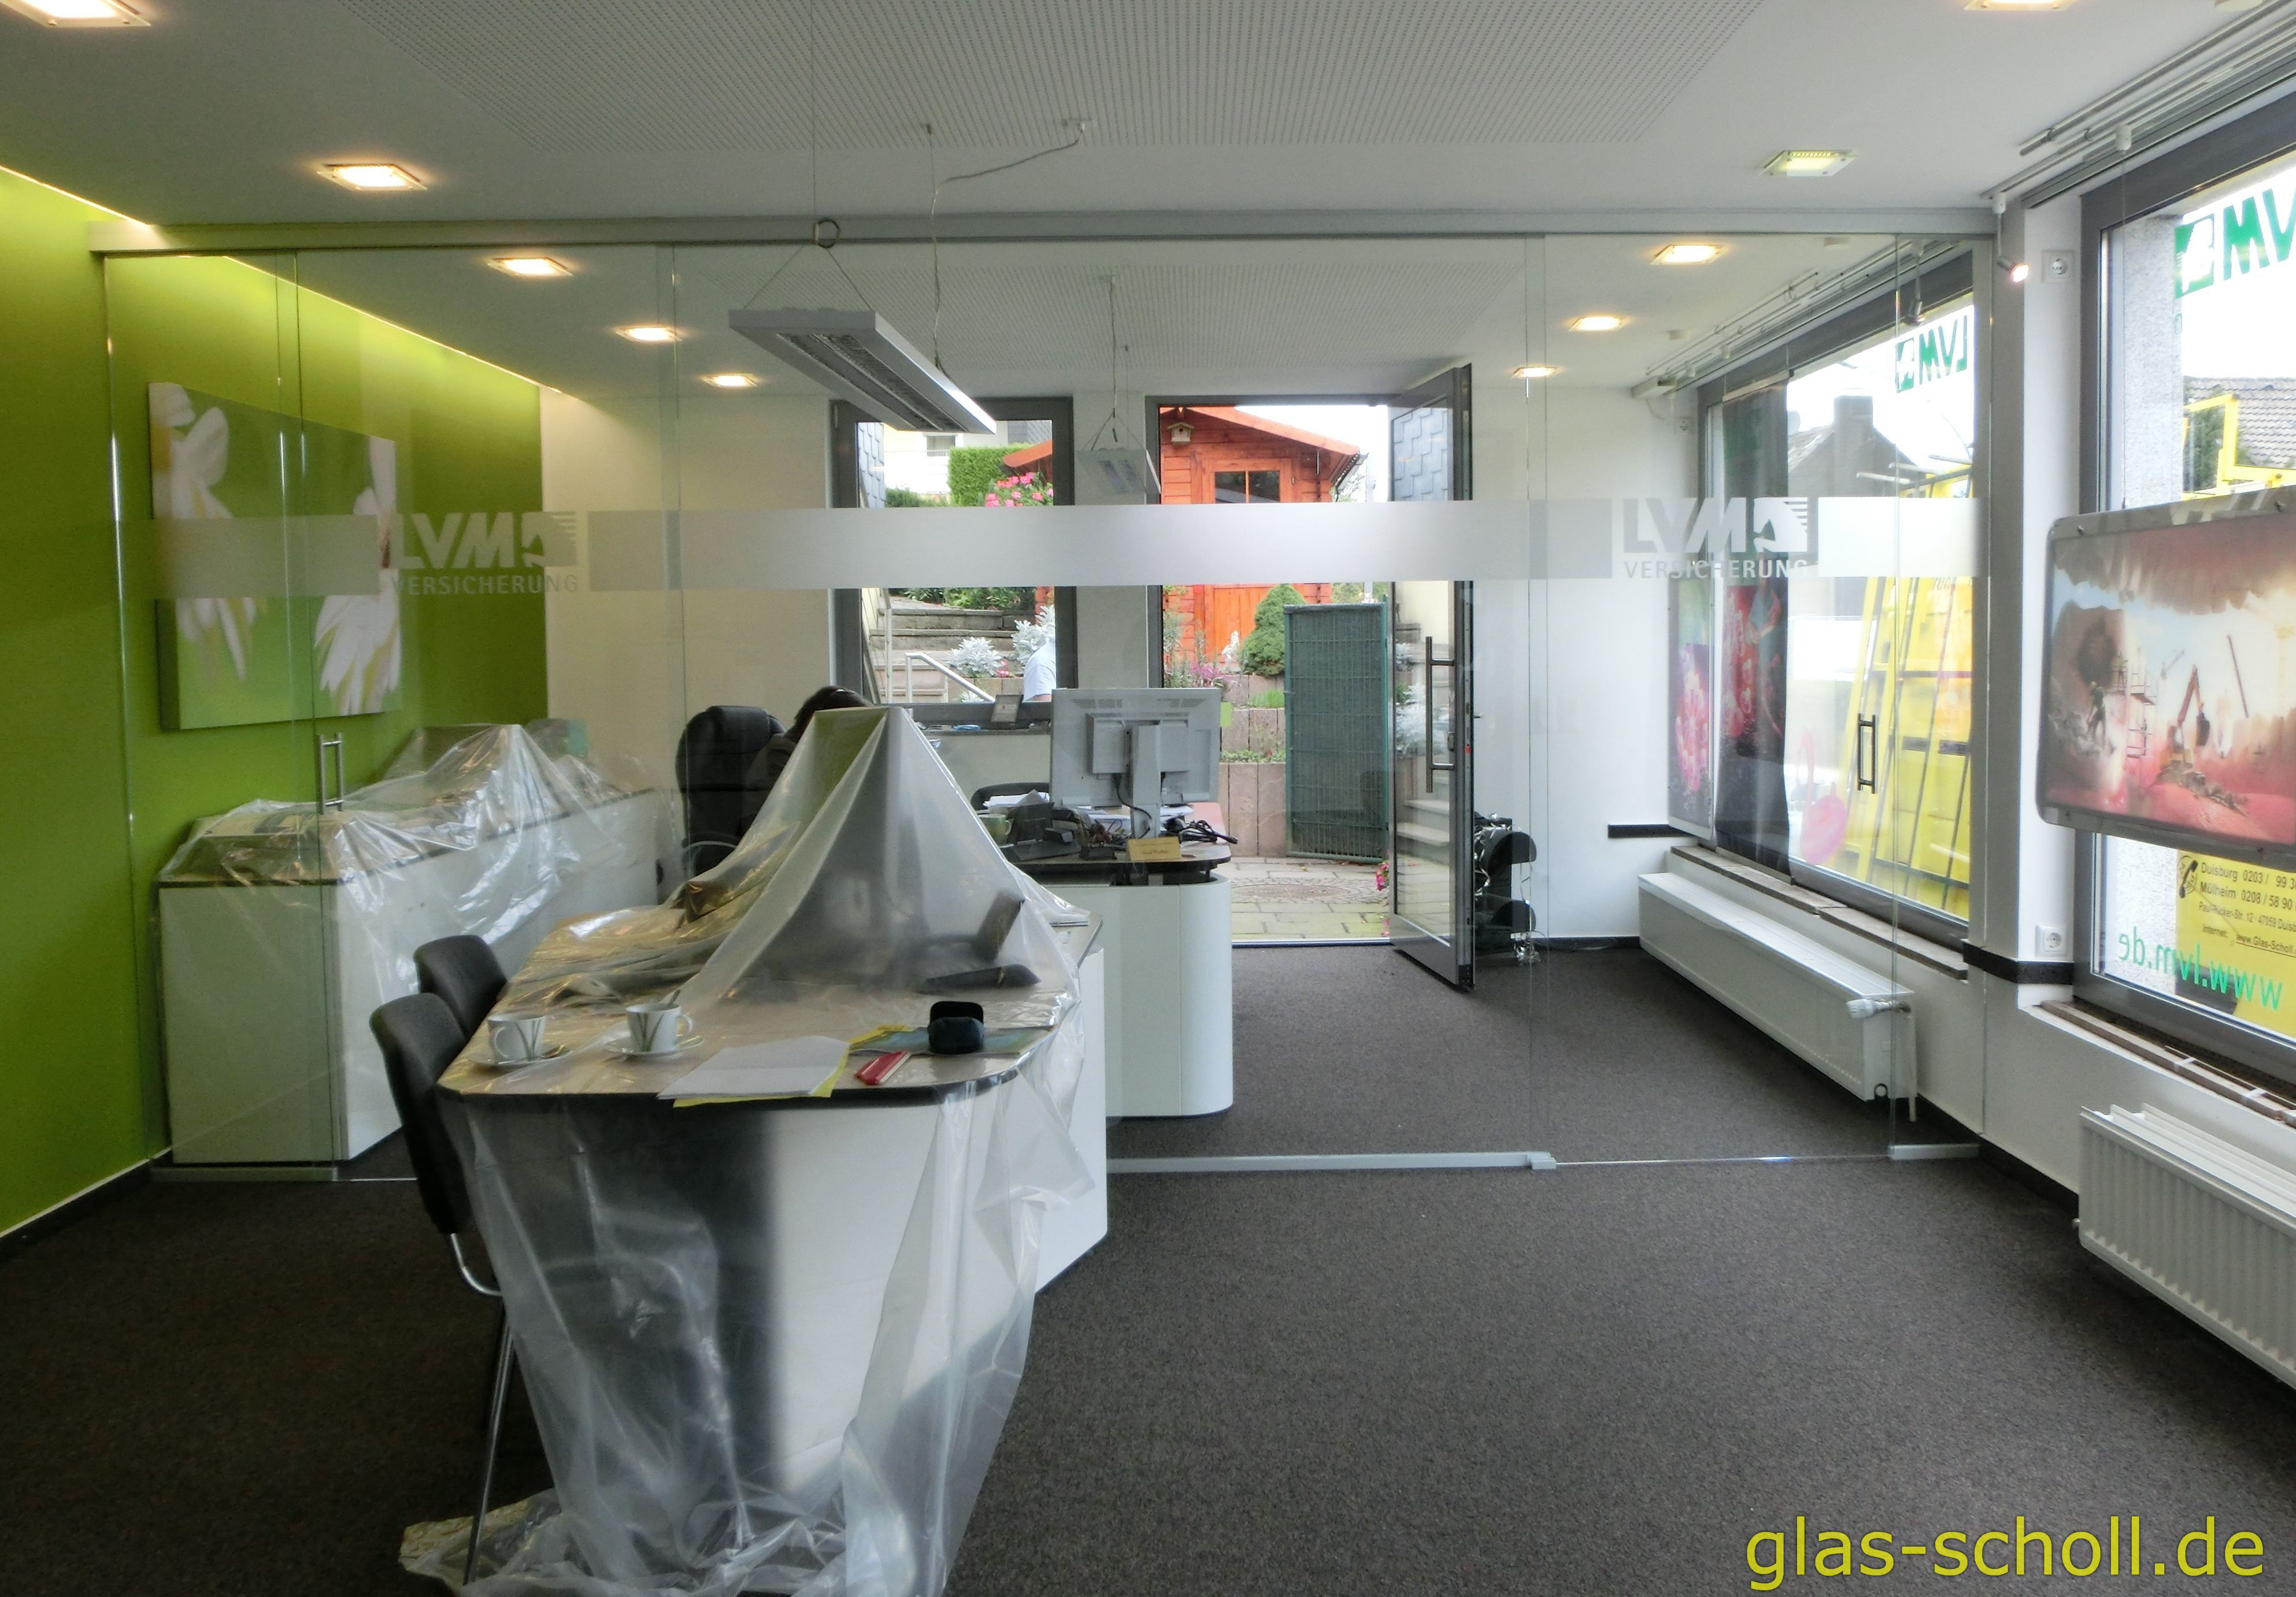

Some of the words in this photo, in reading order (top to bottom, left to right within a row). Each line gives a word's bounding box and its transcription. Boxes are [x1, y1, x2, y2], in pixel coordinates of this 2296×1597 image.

[1623, 498, 1746, 553] LVM
[389, 512, 516, 569] LVM
[392, 575, 577, 595] VERSICHERUNG
[2201, 862, 2238, 882] Duisburg
[2242, 869, 2263, 884] 0203
[2275, 875, 2287, 888] 99
[2200, 881, 2236, 899] Mülheim
[2241, 889, 2261, 904] 0208
[2268, 895, 2279, 908] 58
[2282, 897, 2293, 910] 90
